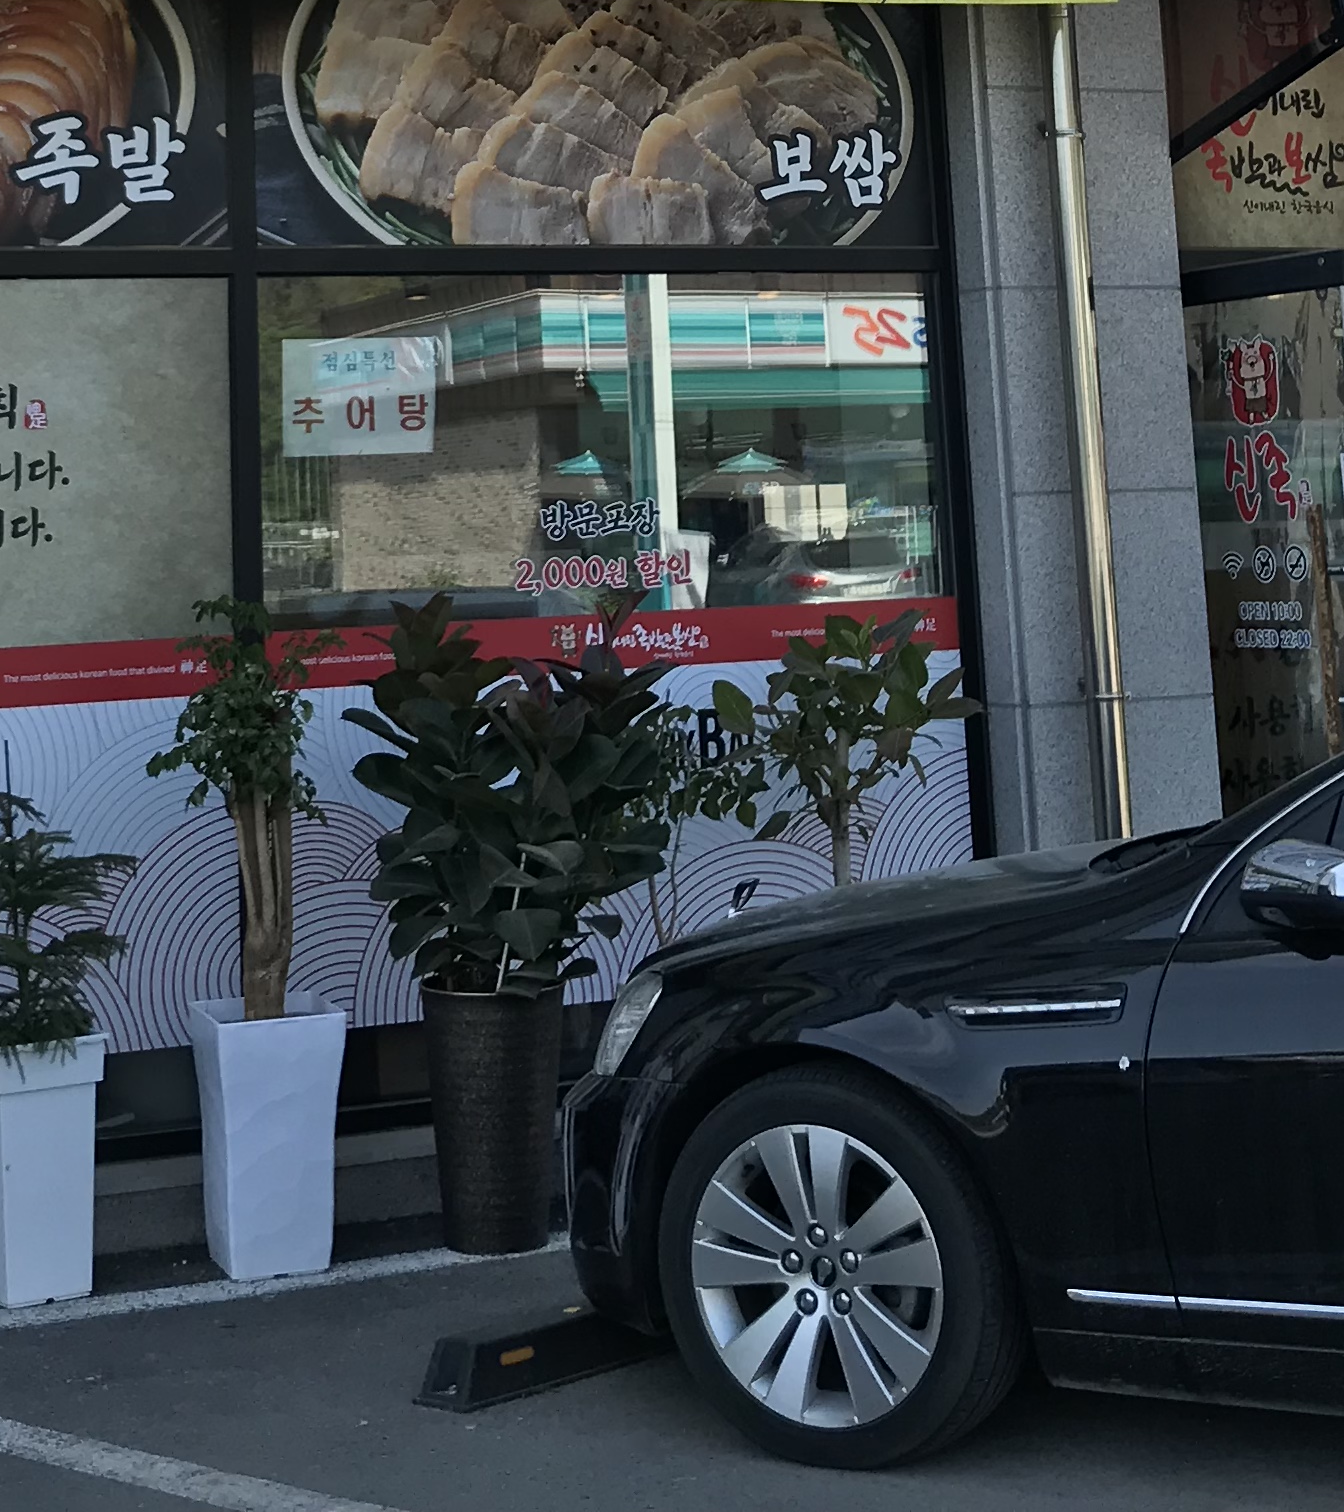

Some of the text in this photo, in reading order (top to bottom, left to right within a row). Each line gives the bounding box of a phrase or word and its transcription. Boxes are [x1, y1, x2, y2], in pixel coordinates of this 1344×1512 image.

[16, 116, 186, 204] 족발
[759, 128, 897, 208] 보쌈
[1243, 199, 1335, 215] 신이내린 한국음식
[322, 350, 397, 372] 점심특선
[1224, 430, 1297, 523] 신족
[540, 497, 660, 540] 방문포장
[515, 548, 693, 597] 2,000원 할인
[1239, 601, 1302, 621] OPEN 10:00
[1234, 629, 1311, 648] CLOSED 22:00
